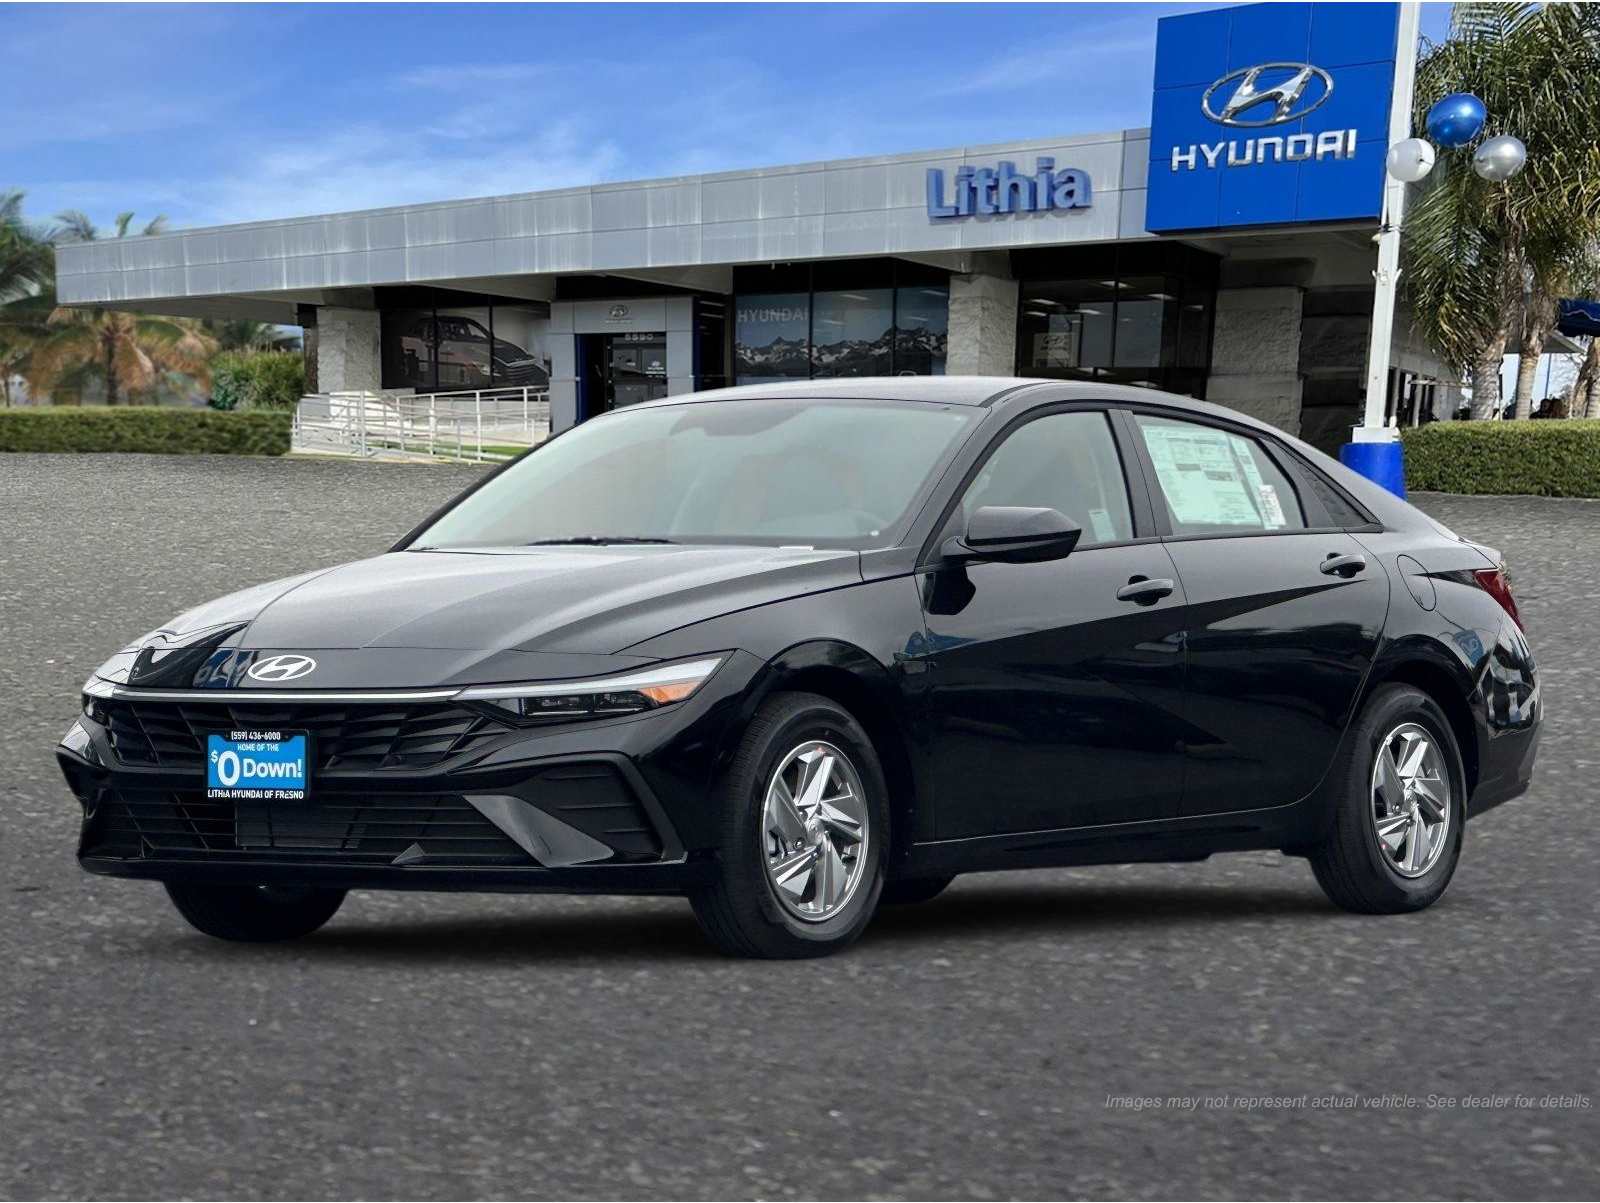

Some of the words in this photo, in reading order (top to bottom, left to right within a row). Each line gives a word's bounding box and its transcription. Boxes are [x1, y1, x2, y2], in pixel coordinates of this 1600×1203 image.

[1171, 128, 1357, 172] HYUNDAI
[926, 156, 1093, 218] Lithia
[737, 307, 809, 322] HYUNDAI
[231, 731, 247, 740] (559)
[249, 731, 281, 740] 436-6000
[237, 743, 255, 751] HOME
[256, 743, 265, 751] OF
[266, 743, 280, 752] THE
[243, 758, 303, 778] Down!
[231, 790, 263, 799] HYUNDAI
[264, 790, 274, 799] OF
